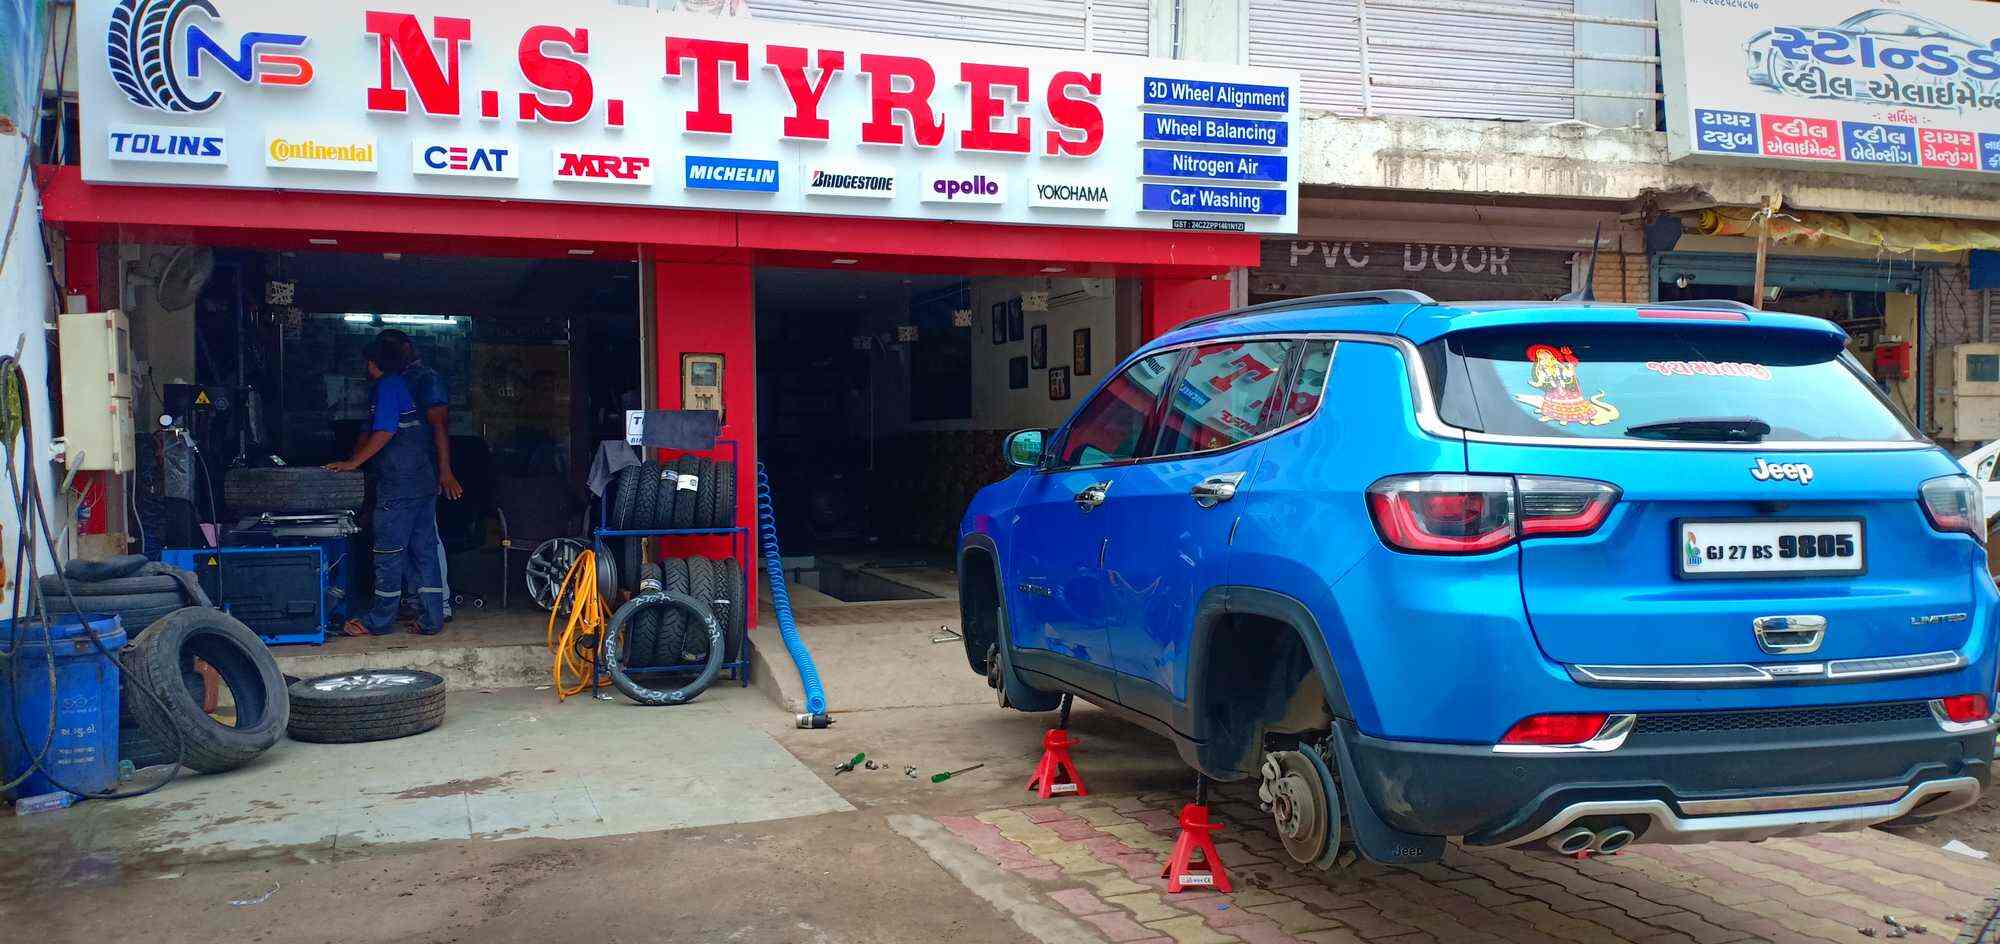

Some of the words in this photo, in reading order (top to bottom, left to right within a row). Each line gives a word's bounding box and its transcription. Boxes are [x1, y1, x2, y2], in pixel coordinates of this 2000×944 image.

[364, 10, 625, 126] N.S.
[664, 35, 1106, 157] TYRES
[1149, 81, 1168, 99] 3D
[1171, 82, 1214, 102] Wheel
[1216, 86, 1286, 107] Alignment
[1156, 118, 1202, 137] Wheel
[1205, 121, 1277, 144] Balancing
[110, 132, 224, 157] TOLINS
[269, 138, 374, 164] Continental
[424, 145, 509, 172] CEAT
[557, 152, 650, 180] MRF
[1172, 154, 1234, 176] Nitrogen
[1237, 158, 1259, 174] Air
[689, 164, 776, 184] MICHELIN
[810, 169, 894, 191] BRIDGESTONE
[933, 175, 999, 200] apollo
[1036, 184, 1109, 203] YOKOHAMA
[1170, 188, 1196, 206] Car
[1199, 191, 1261, 212] Washing
[1173, 219, 1188, 229] GST
[1289, 241, 1370, 268] PVC
[1403, 244, 1512, 276] DOOR
[1751, 458, 1814, 485] Jeep
[1706, 545, 1724, 560] GJ
[1728, 545, 1747, 560] 27
[1752, 545, 1773, 560] BS
[1778, 533, 1855, 560] 9805
